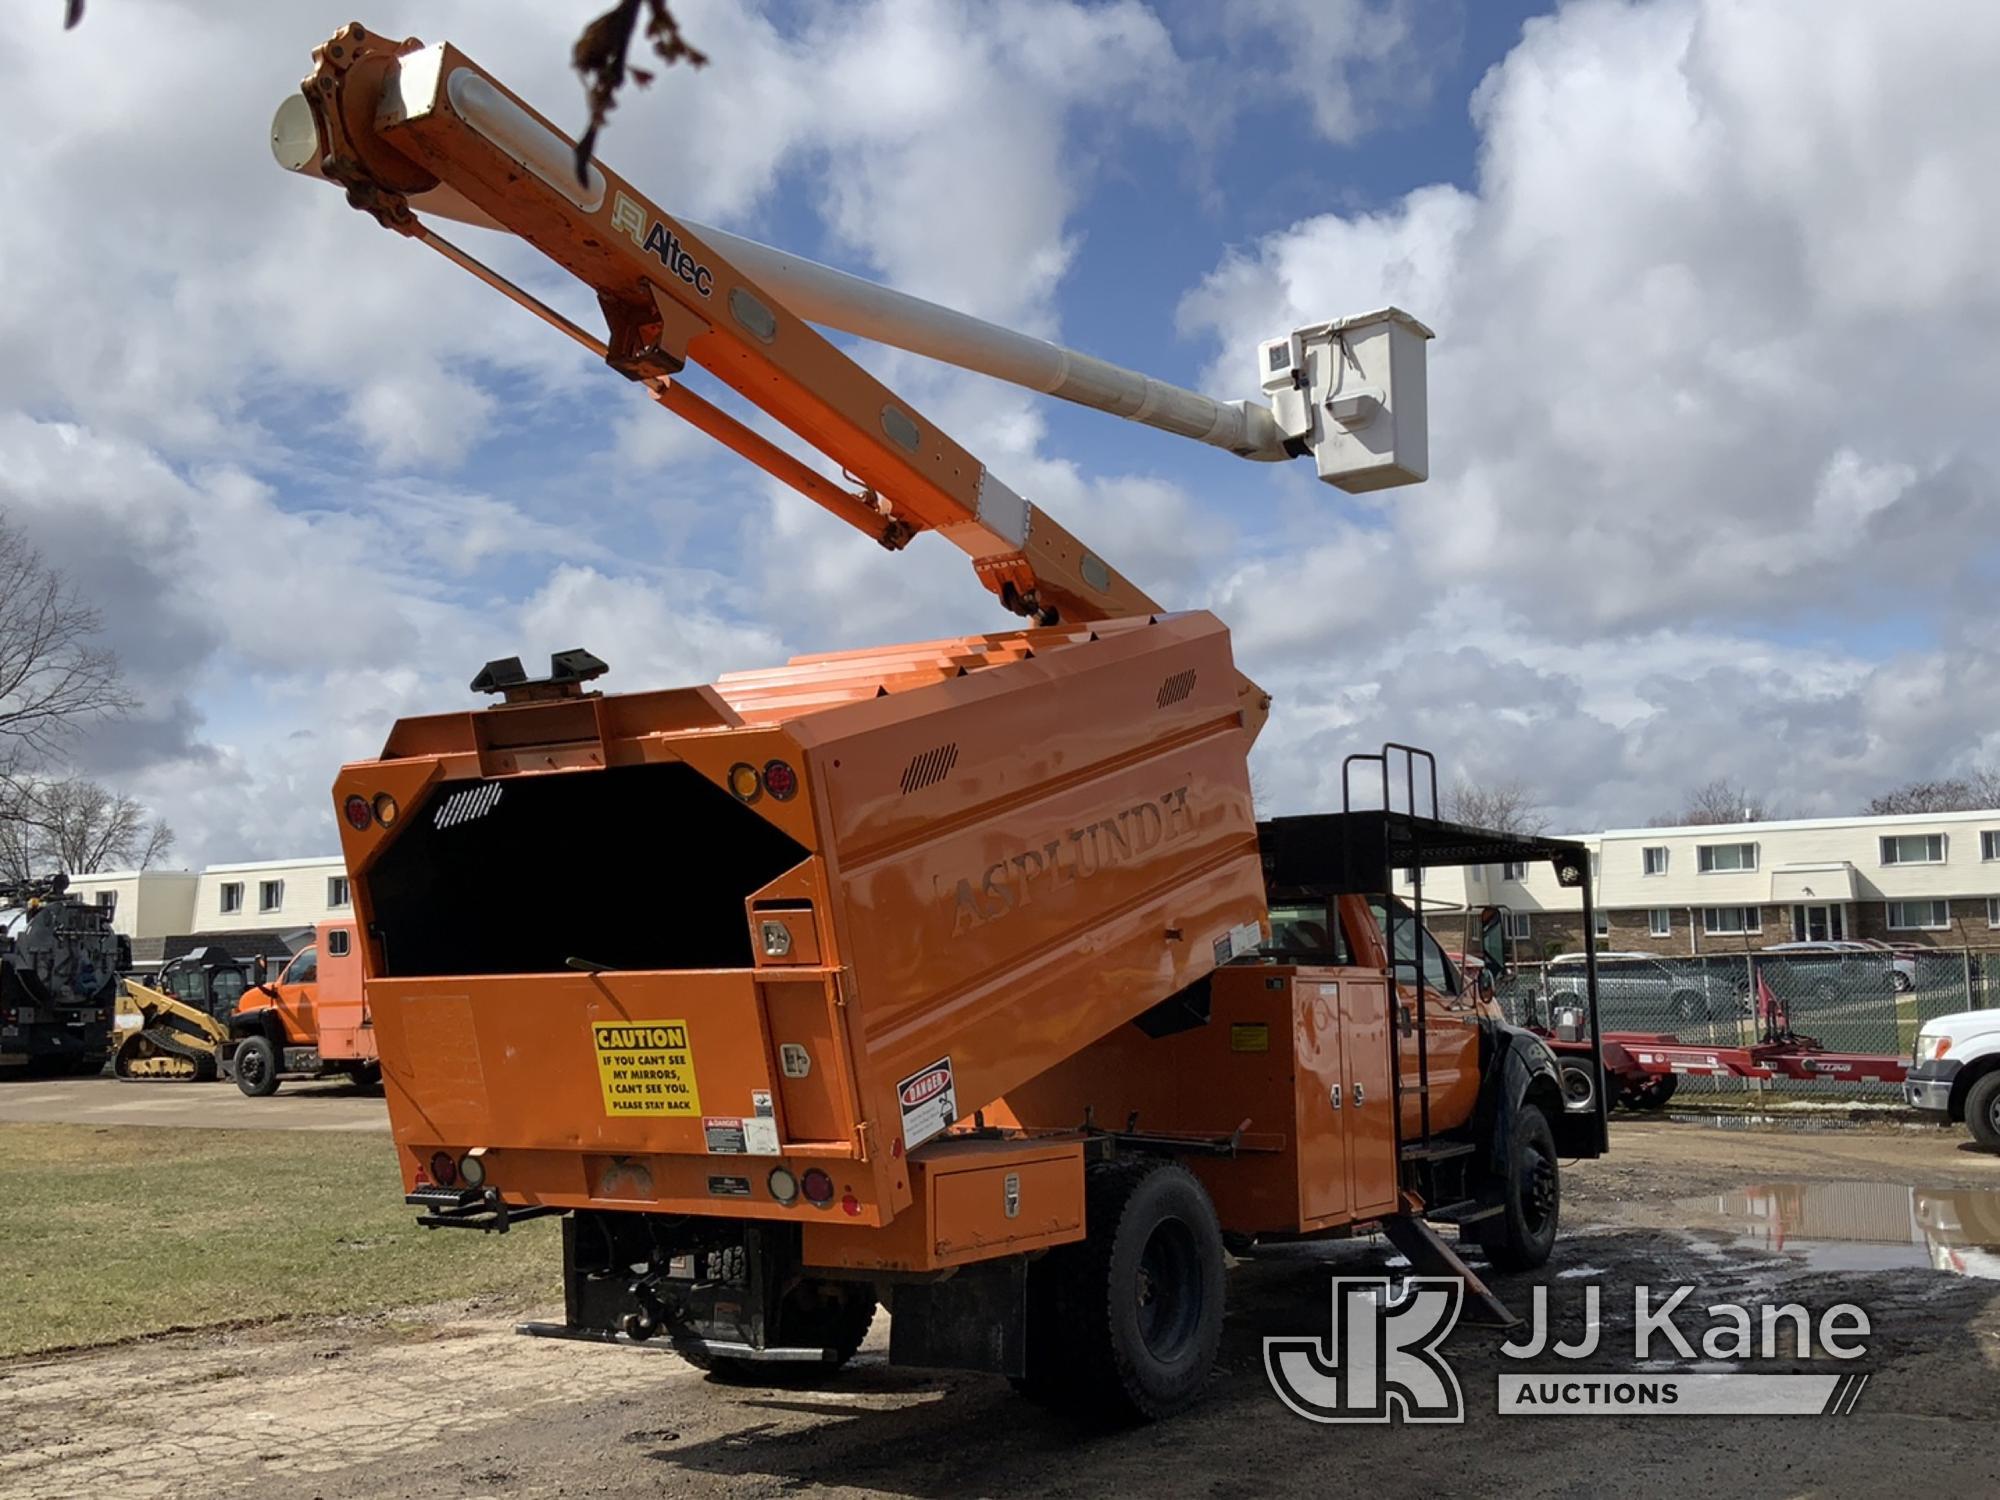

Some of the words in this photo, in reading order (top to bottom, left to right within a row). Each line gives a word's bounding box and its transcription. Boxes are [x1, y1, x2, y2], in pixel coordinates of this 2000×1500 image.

[642, 221, 713, 297] Altec
[951, 786, 1196, 938] ASPLUNDH
[598, 1029, 683, 1048] CAUTION
[603, 1056, 611, 1065] IF
[614, 1056, 635, 1065] YOU
[638, 1056, 665, 1065] CAN'T
[669, 1055, 686, 1064] SEE
[613, 1070, 627, 1079] MY
[631, 1070, 680, 1080] MIRRORS,
[615, 1084, 642, 1093] CAN'T
[645, 1084, 662, 1093] SEE
[664, 1084, 690, 1093] YOU.
[909, 1072, 943, 1102] DANGER
[613, 1101, 642, 1110] PLEASE
[645, 1101, 665, 1109] STAY
[667, 1101, 691, 1110] BACK
